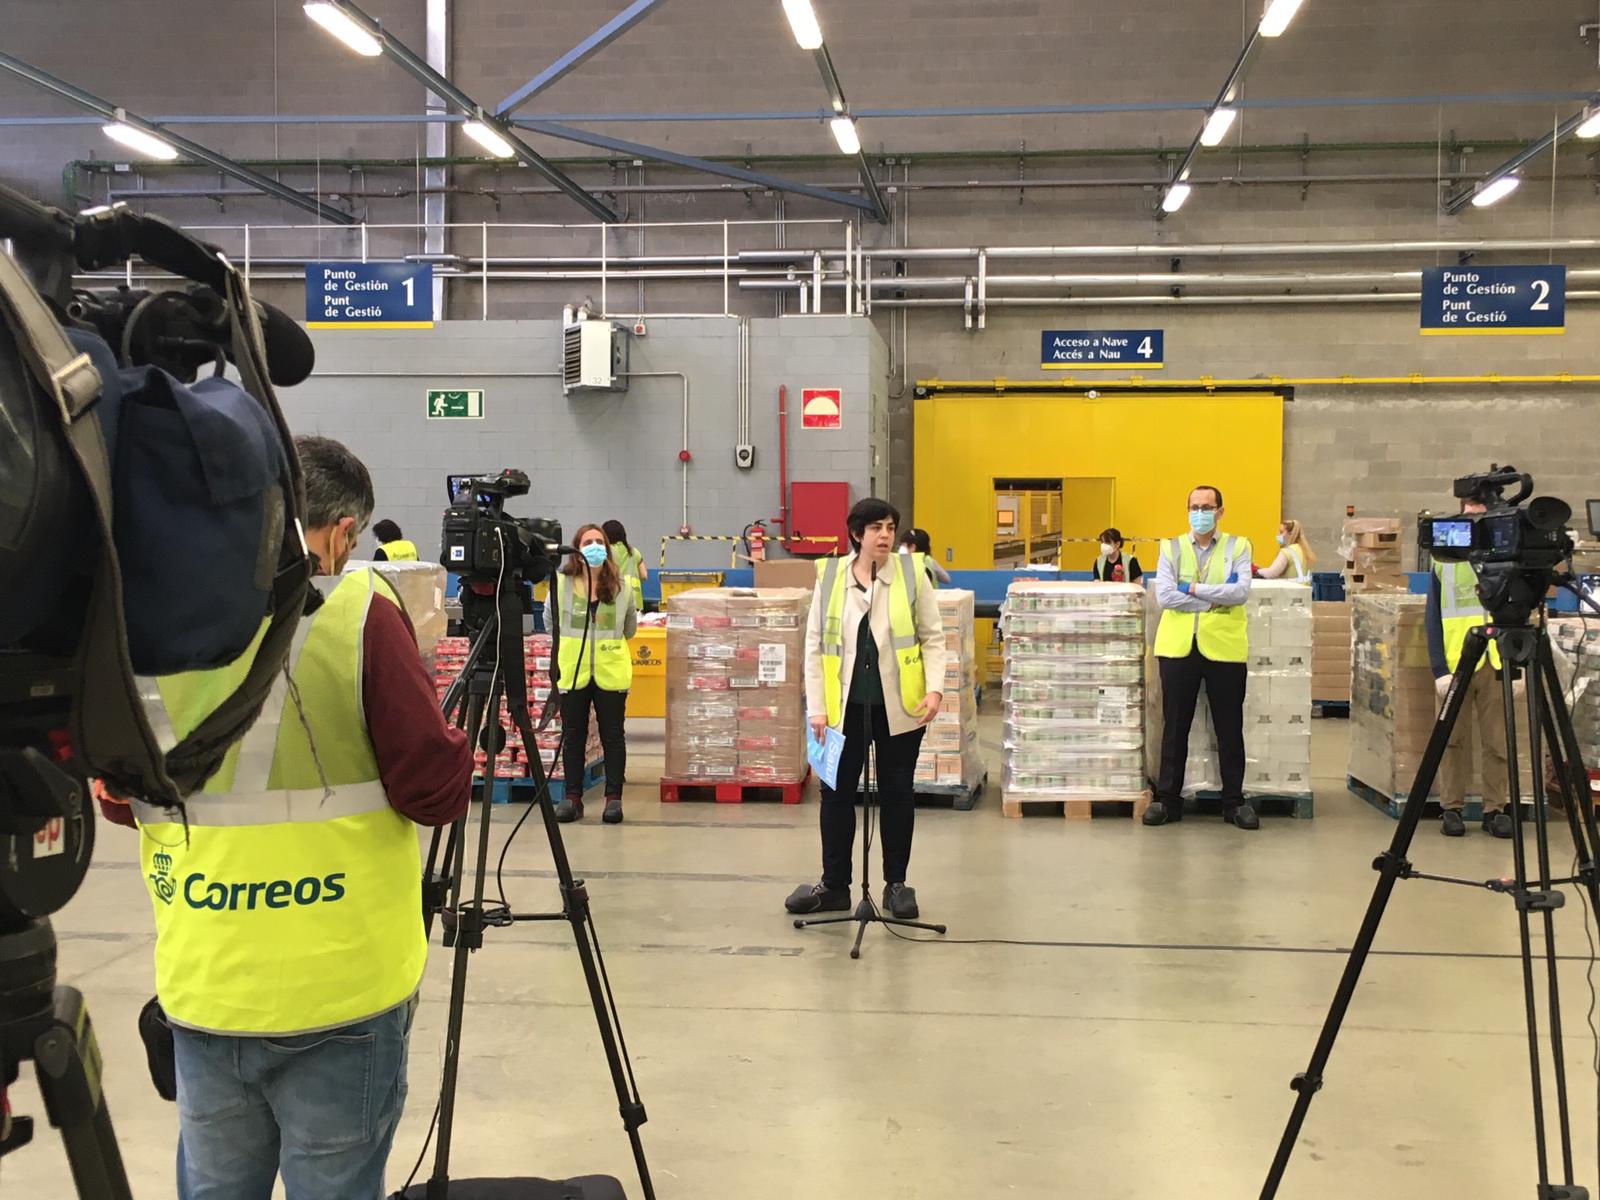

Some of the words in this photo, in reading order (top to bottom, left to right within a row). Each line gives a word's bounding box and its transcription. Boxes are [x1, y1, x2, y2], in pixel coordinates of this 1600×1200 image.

[324, 269, 356, 279] Punto
[1443, 272, 1480, 283] Punto
[324, 280, 338, 291] de
[345, 280, 388, 291] Gestión
[1443, 283, 1459, 295] de
[1466, 283, 1516, 294] Gestión
[401, 277, 414, 306] 1
[1530, 280, 1550, 311] 2
[324, 295, 350, 305] Punt
[1442, 299, 1471, 310] Punt
[325, 306, 339, 317] de
[345, 306, 382, 317] Gestió
[1442, 311, 1458, 322] de
[1466, 310, 1507, 322] Gestió
[1053, 337, 1090, 347] Acceso
[1093, 339, 1099, 347] a
[1102, 337, 1128, 347] Nave
[1136, 336, 1153, 359] 4
[1053, 349, 1083, 359] Accés
[1088, 351, 1094, 359] a
[1099, 350, 1120, 359] Nau
[183, 872, 346, 911] Correos
